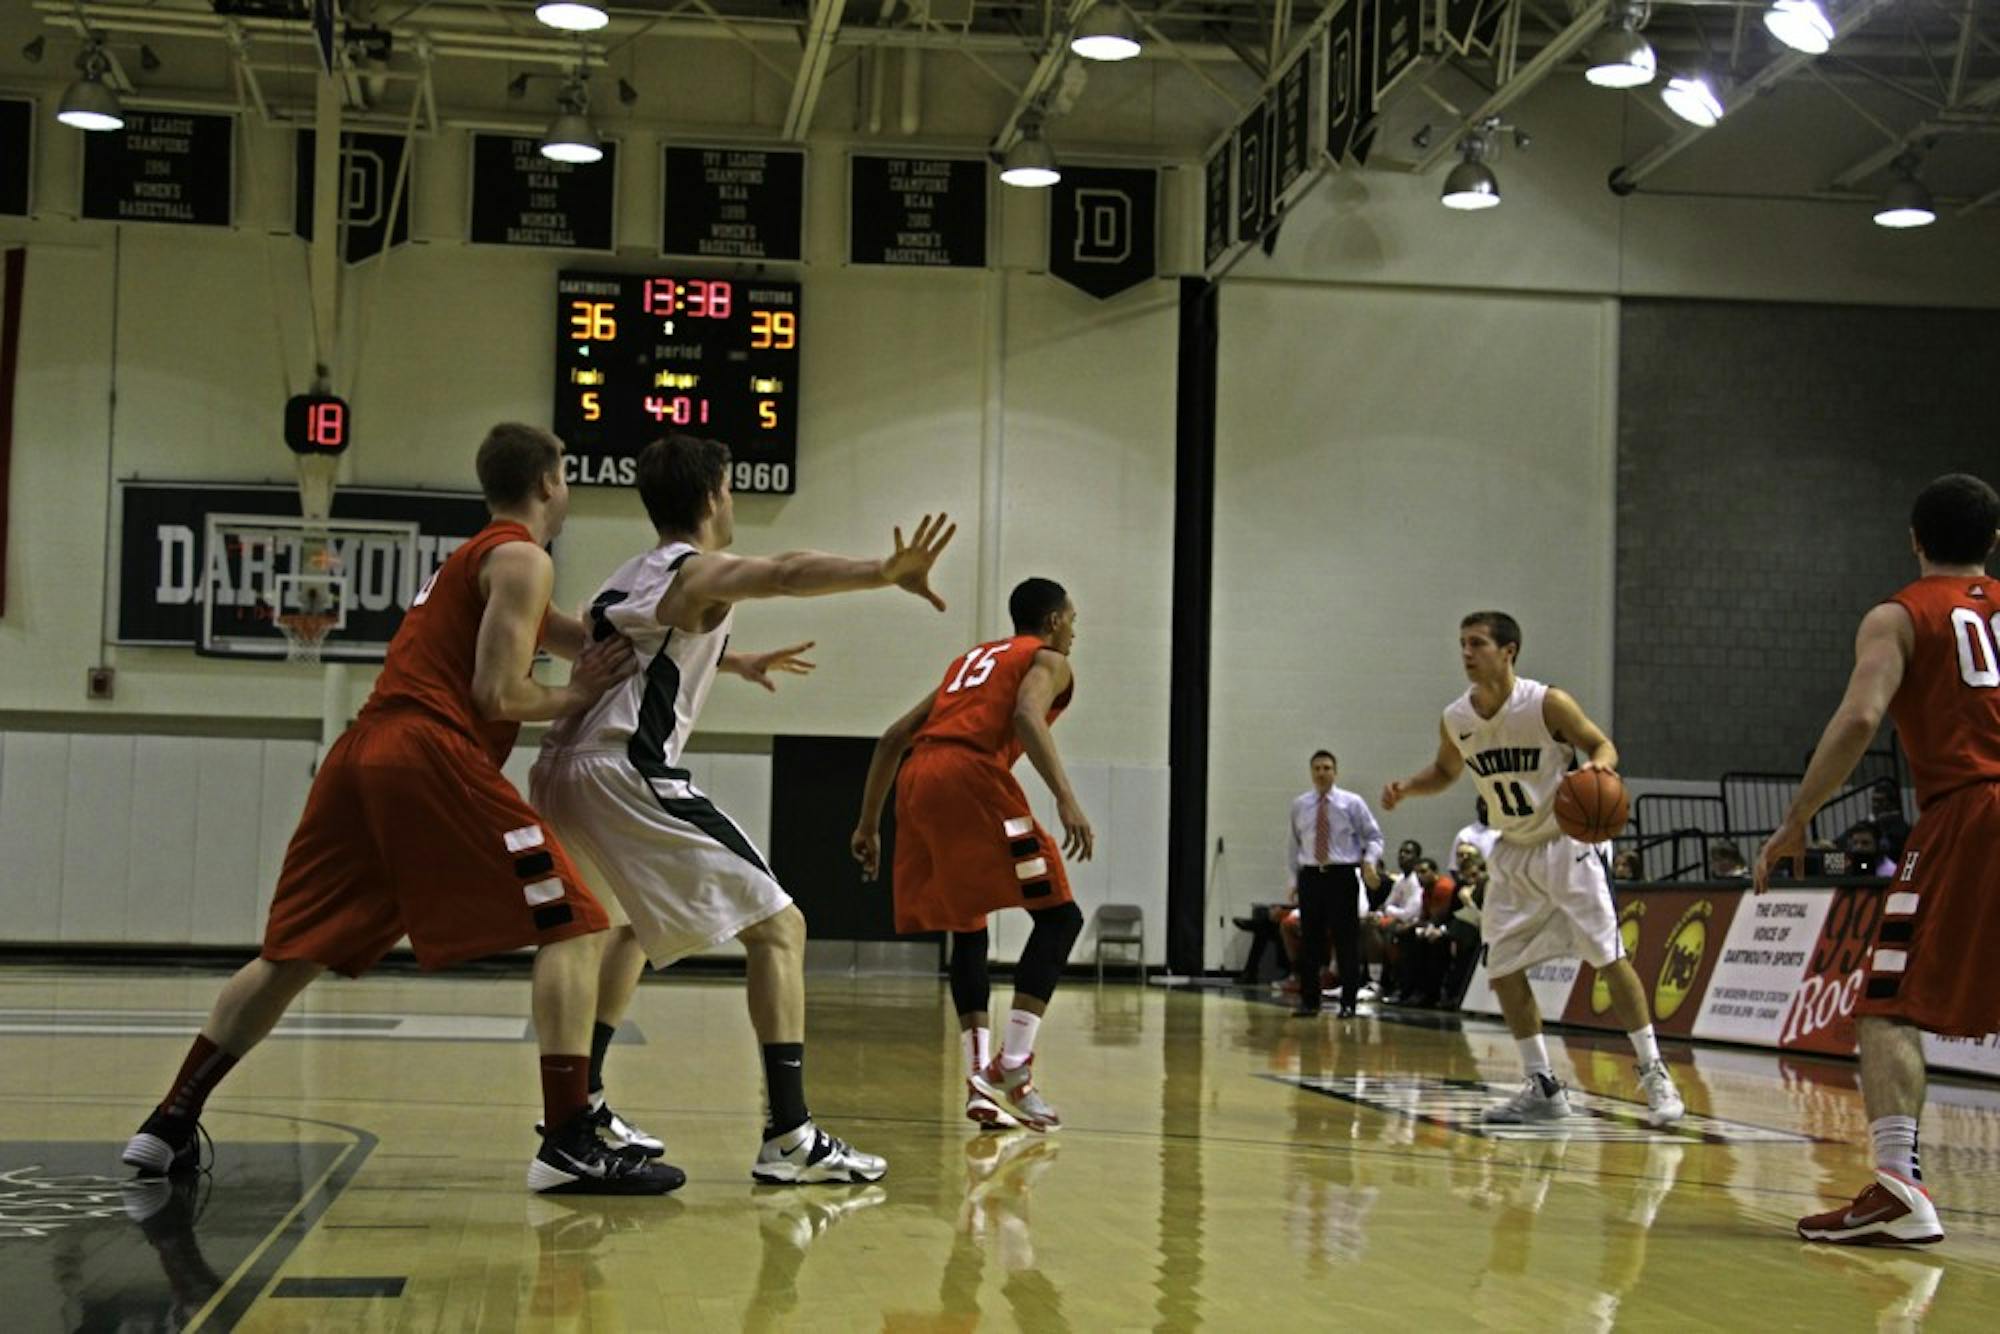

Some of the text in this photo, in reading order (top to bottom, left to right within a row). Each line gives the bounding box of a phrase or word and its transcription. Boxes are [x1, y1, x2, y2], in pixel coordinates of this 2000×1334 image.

[151, 118, 193, 135] LEAGUE
[727, 153, 767, 168] LEAGUE
[912, 161, 951, 176] LEAGUE
[705, 168, 763, 184] CHAMPIONS
[889, 176, 949, 192] CHAMPIONS
[118, 199, 195, 219] BASKETBALL
[506, 227, 576, 245] BASKETBALL
[1074, 189, 1132, 263] D
[699, 239, 765, 256] BASKETBALL
[884, 247, 951, 264] BASKETBALL
[643, 278, 732, 319] 13:38
[571, 301, 617, 341] 36
[751, 311, 796, 349] 39
[581, 392, 601, 421] 5
[758, 400, 777, 429] 5
[307, 403, 343, 445] 18
[562, 454, 637, 485] CLAS
[1951, 607, 2000, 687] 0
[947, 643, 1012, 693] 15
[1494, 782, 1534, 816] 11
[1756, 903, 1808, 918] THE OFFICIAL
[1754, 927, 1791, 942] VOICE OF
[1724, 949, 1806, 967] DARTMOUTH SPORTS
[1782, 968, 1866, 1043] Roc
